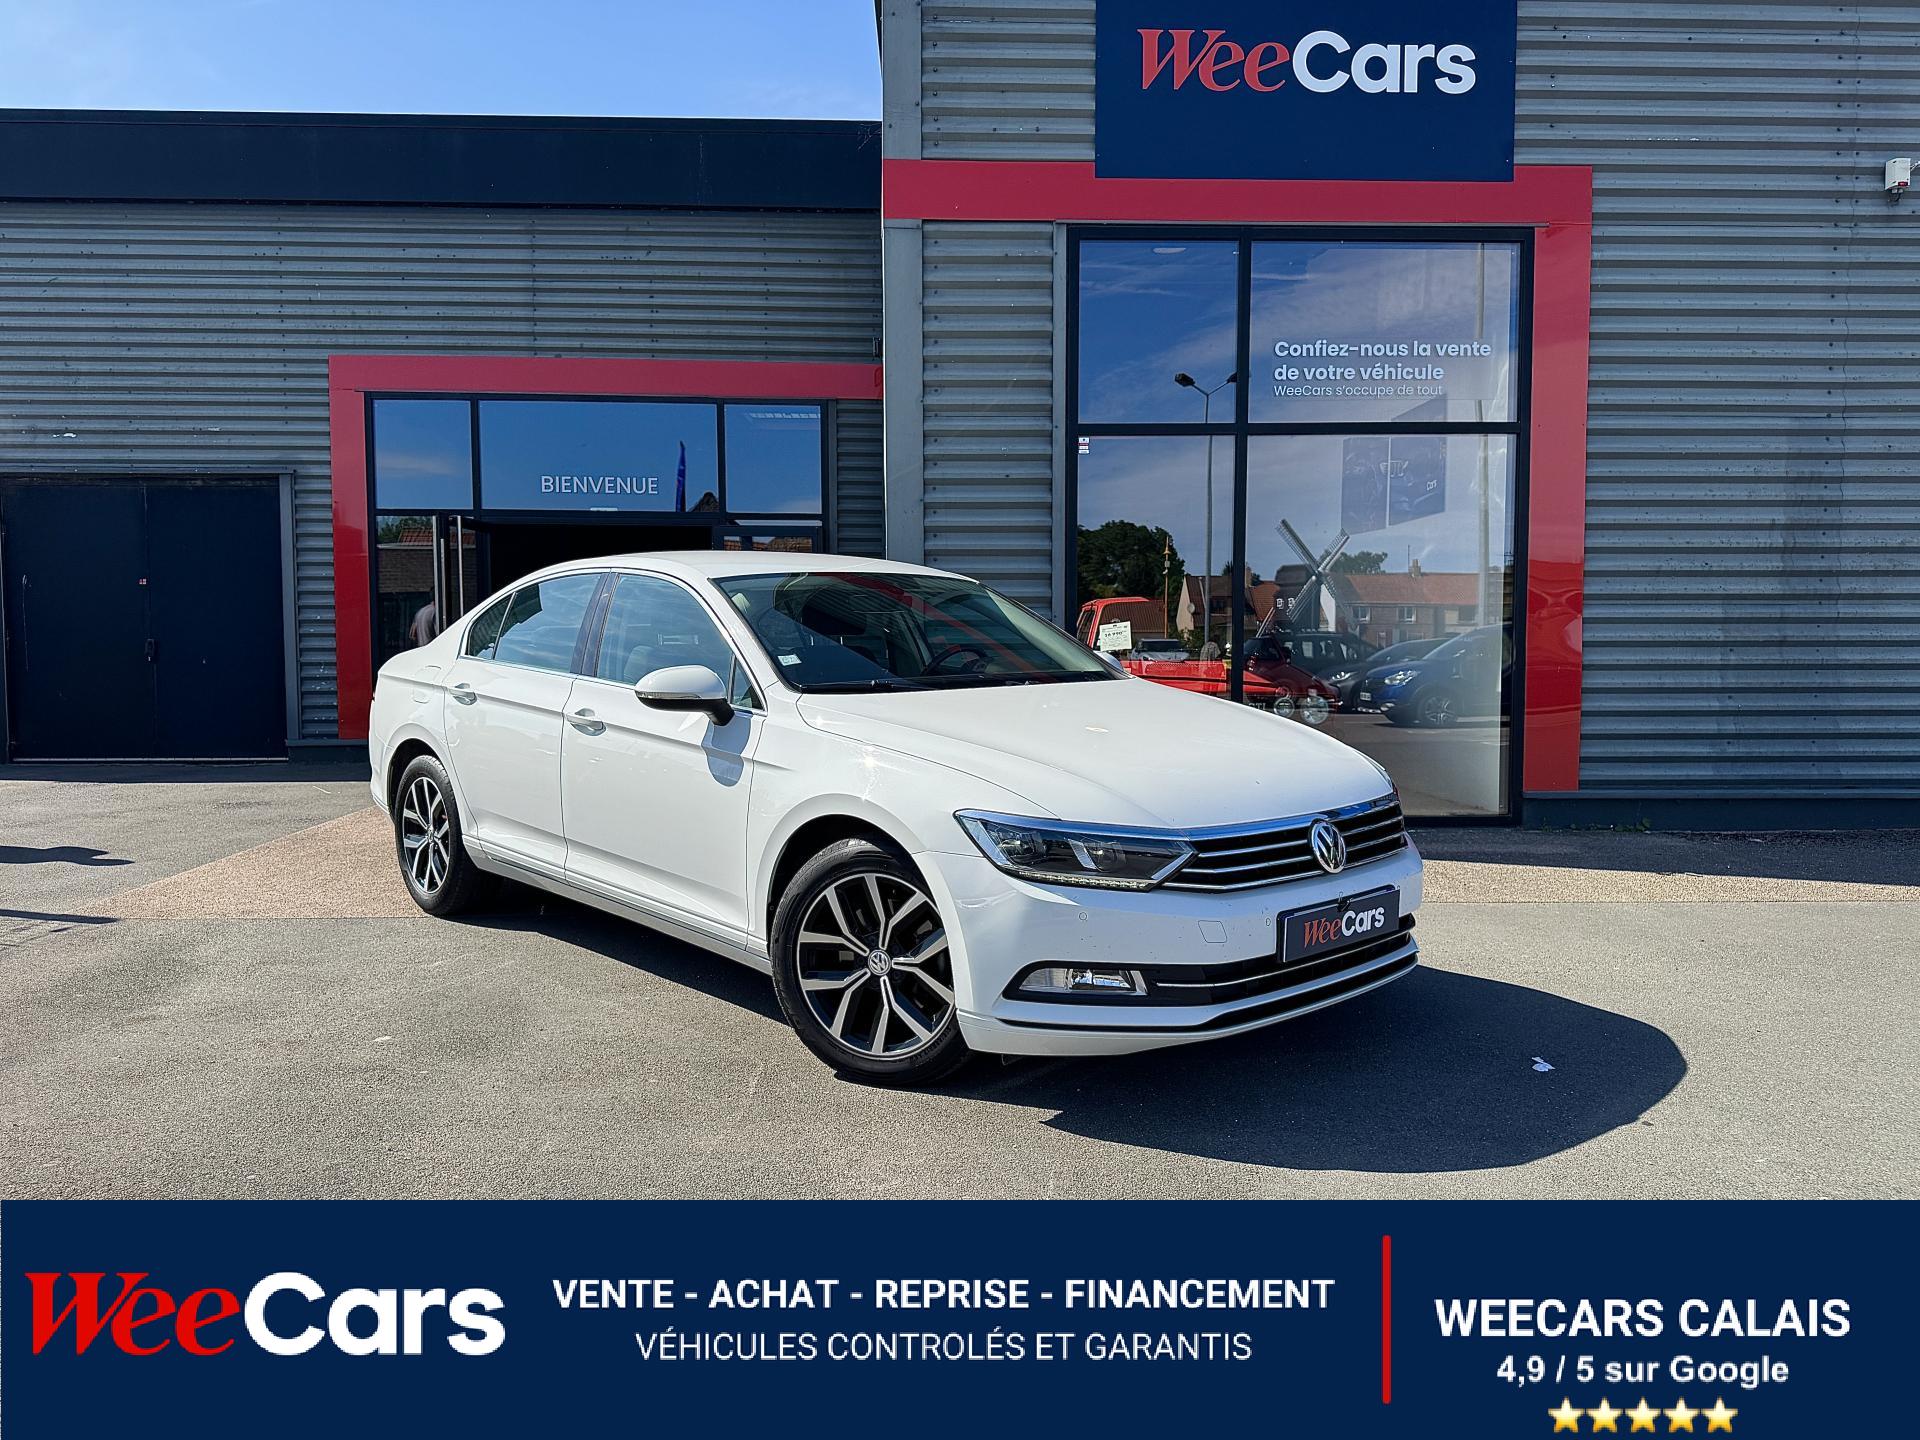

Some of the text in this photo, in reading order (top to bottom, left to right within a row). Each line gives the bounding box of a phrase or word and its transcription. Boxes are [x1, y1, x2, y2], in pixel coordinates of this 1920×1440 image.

[1137, 28, 1476, 95] WeeCars
[1274, 339, 1492, 357] Confiez-nous la vente
[1274, 362, 1445, 380] de votre véhicule
[1274, 385, 1332, 396] WeeCars
[1397, 384, 1414, 396] de
[1417, 385, 1443, 396] tout
[541, 475, 659, 494] BIENVENUE
[1304, 906, 1385, 949] WeeCars
